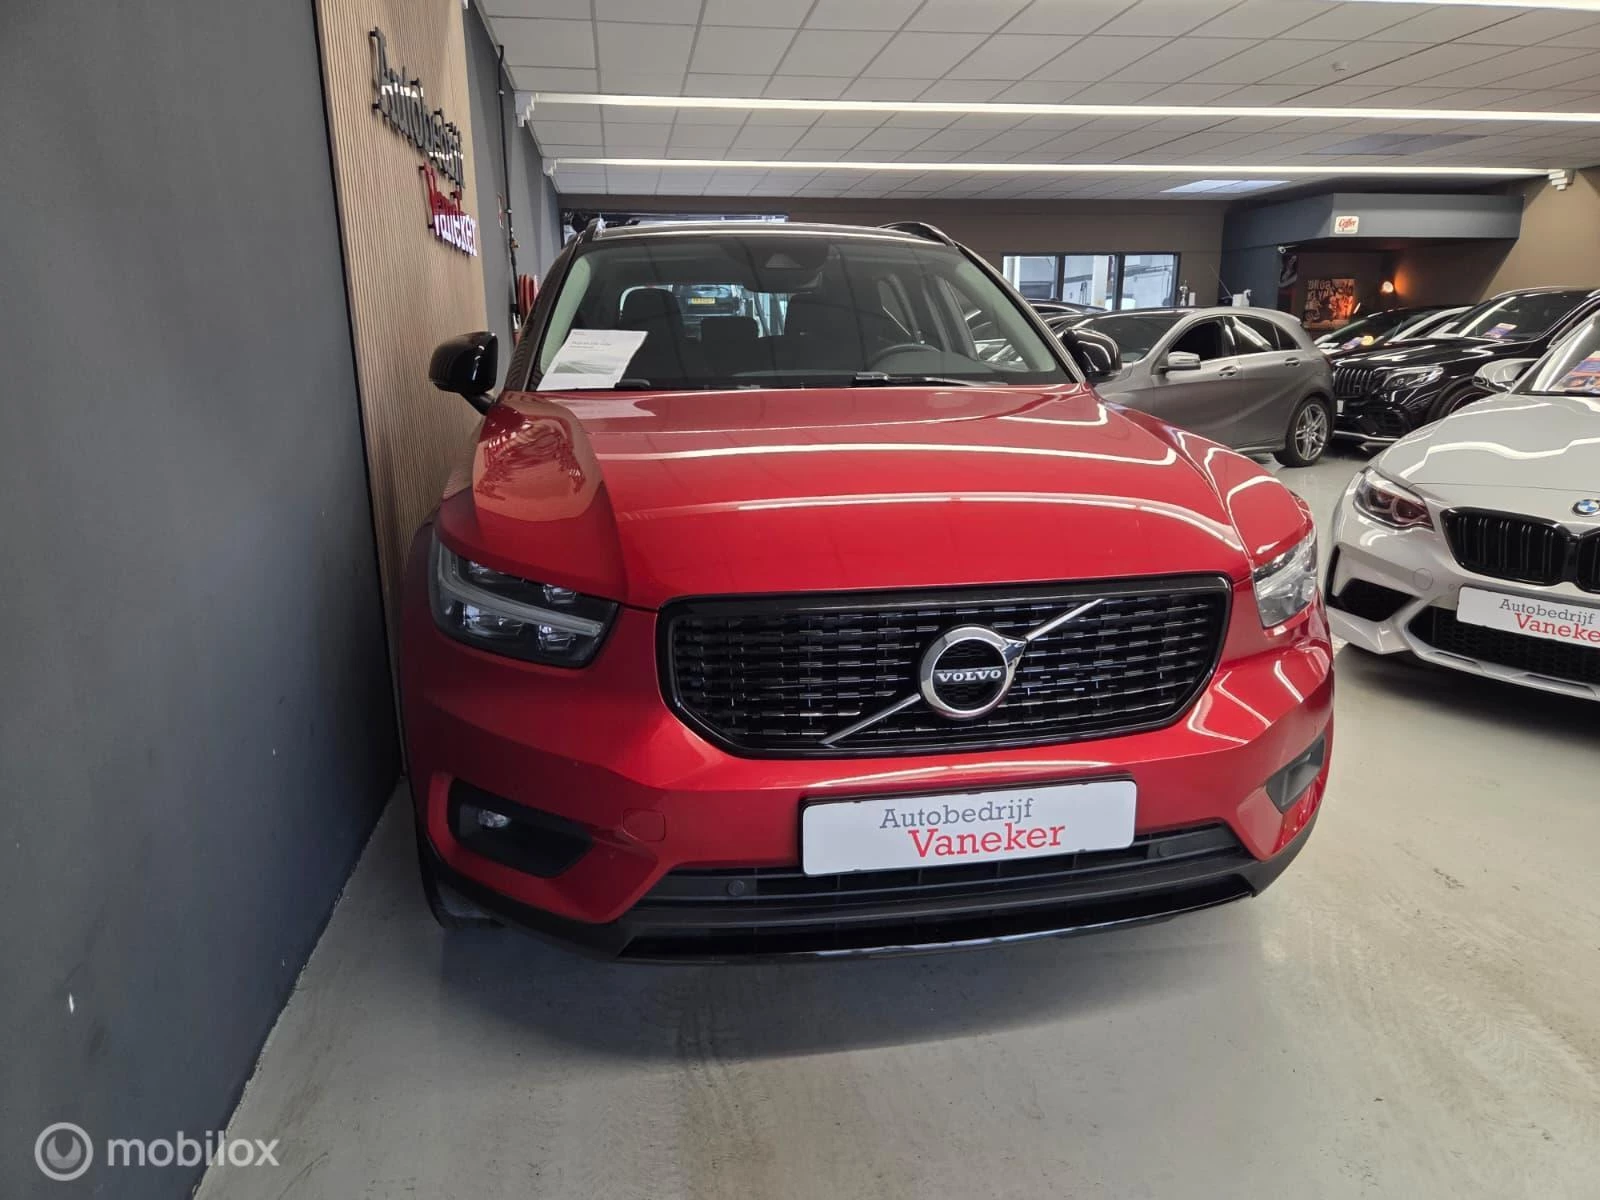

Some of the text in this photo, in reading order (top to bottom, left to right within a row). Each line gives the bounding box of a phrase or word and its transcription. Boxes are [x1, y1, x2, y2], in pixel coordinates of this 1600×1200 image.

[1499, 598, 1595, 626] Autobedrijf
[937, 669, 1002, 682] VOLVO
[879, 797, 1034, 829] Autobedrijf
[907, 822, 1065, 858] Vaneker
